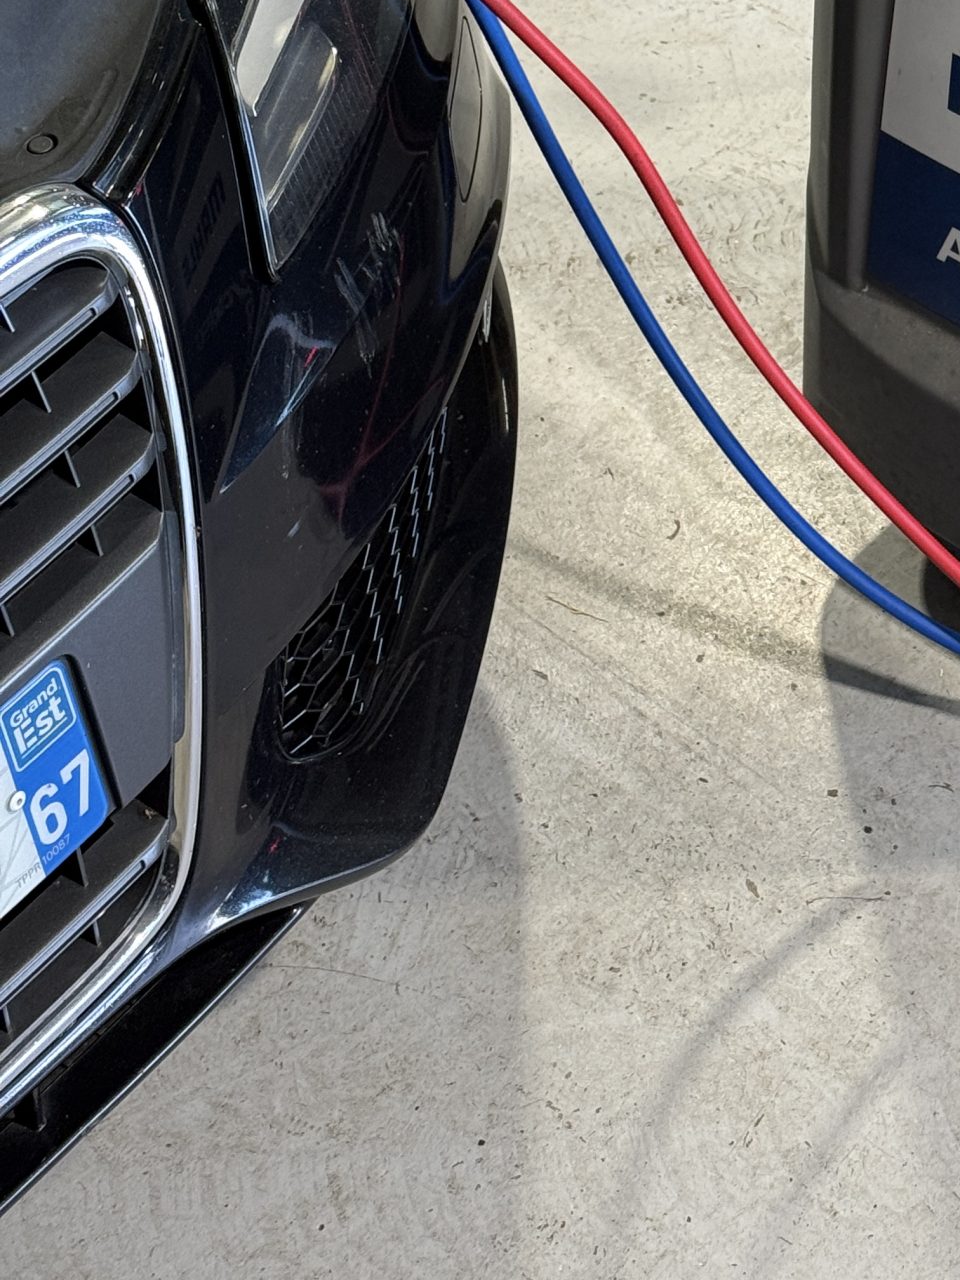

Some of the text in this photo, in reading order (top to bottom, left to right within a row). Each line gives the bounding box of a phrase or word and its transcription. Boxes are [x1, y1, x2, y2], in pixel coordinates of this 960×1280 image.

[10, 678, 59, 728] Grand
[13, 696, 65, 754] Est
[30, 748, 90, 845] 67
[42, 833, 70, 866] 10087
